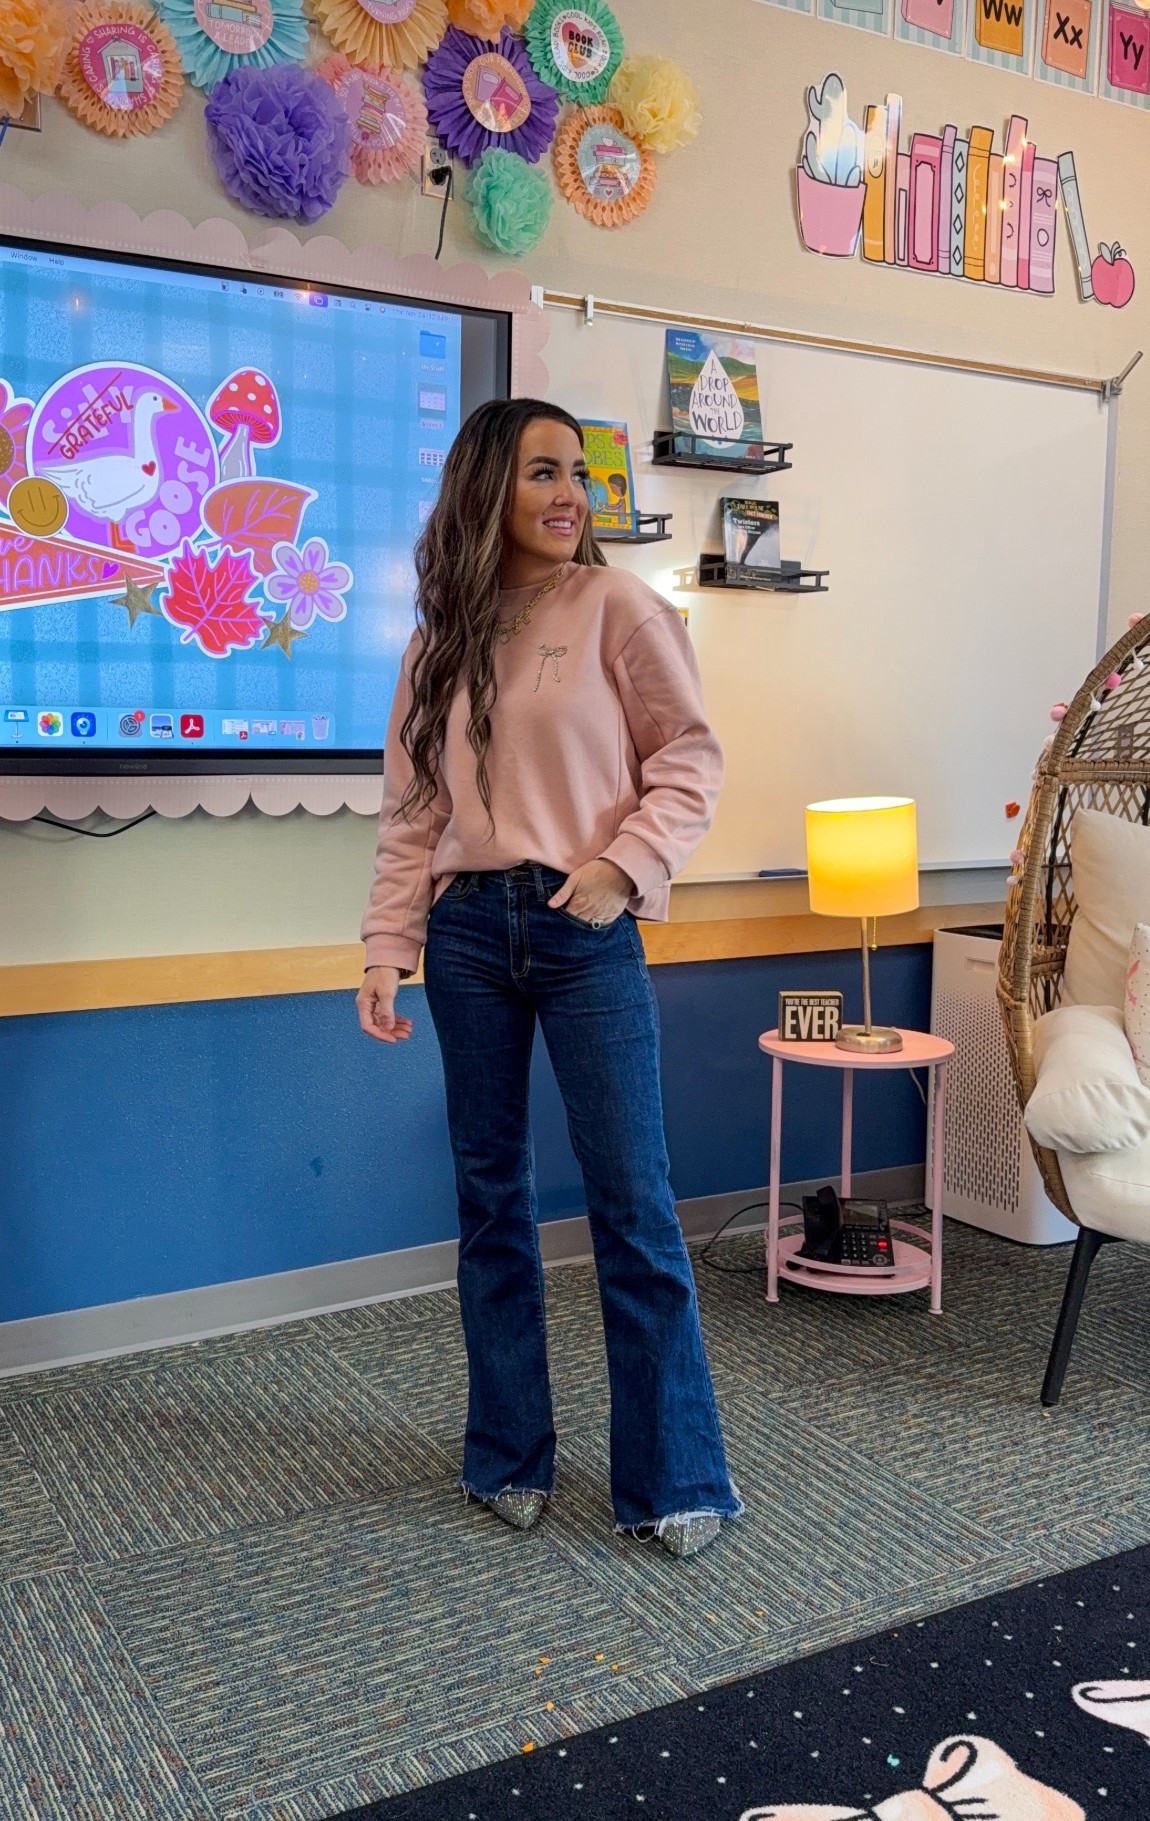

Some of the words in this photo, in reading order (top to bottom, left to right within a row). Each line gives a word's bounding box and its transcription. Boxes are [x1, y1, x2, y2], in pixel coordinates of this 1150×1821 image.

[566, 11, 582, 20] COOL
[983, 0, 1022, 27] Ww
[94, 26, 135, 39] SHARING
[553, 17, 564, 38] BOOKS
[1054, 12, 1083, 49] Xx
[138, 34, 148, 43] IS
[223, 32, 254, 48] LEADE
[568, 30, 593, 47] BOOK
[568, 41, 592, 58] CLUB
[1119, 31, 1144, 70] Yy
[81, 47, 97, 82] CARING
[574, 71, 590, 79] COOL
[10, 251, 37, 262] Window
[48, 257, 65, 266] Help
[710, 359, 717, 375] A
[700, 375, 729, 393] DROP
[691, 391, 738, 409] AROUND
[59, 391, 134, 460] GRATEFUL
[692, 410, 743, 434] WORLD
[585, 433, 605, 449] PS
[585, 450, 624, 467] OBES
[125, 436, 212, 548] GOOSE
[733, 517, 761, 526] Twisters
[0, 535, 34, 556] ve
[0, 551, 101, 593] HANKS
[821, 998, 840, 1006] TEACHER
[785, 1006, 839, 1040] EVER
